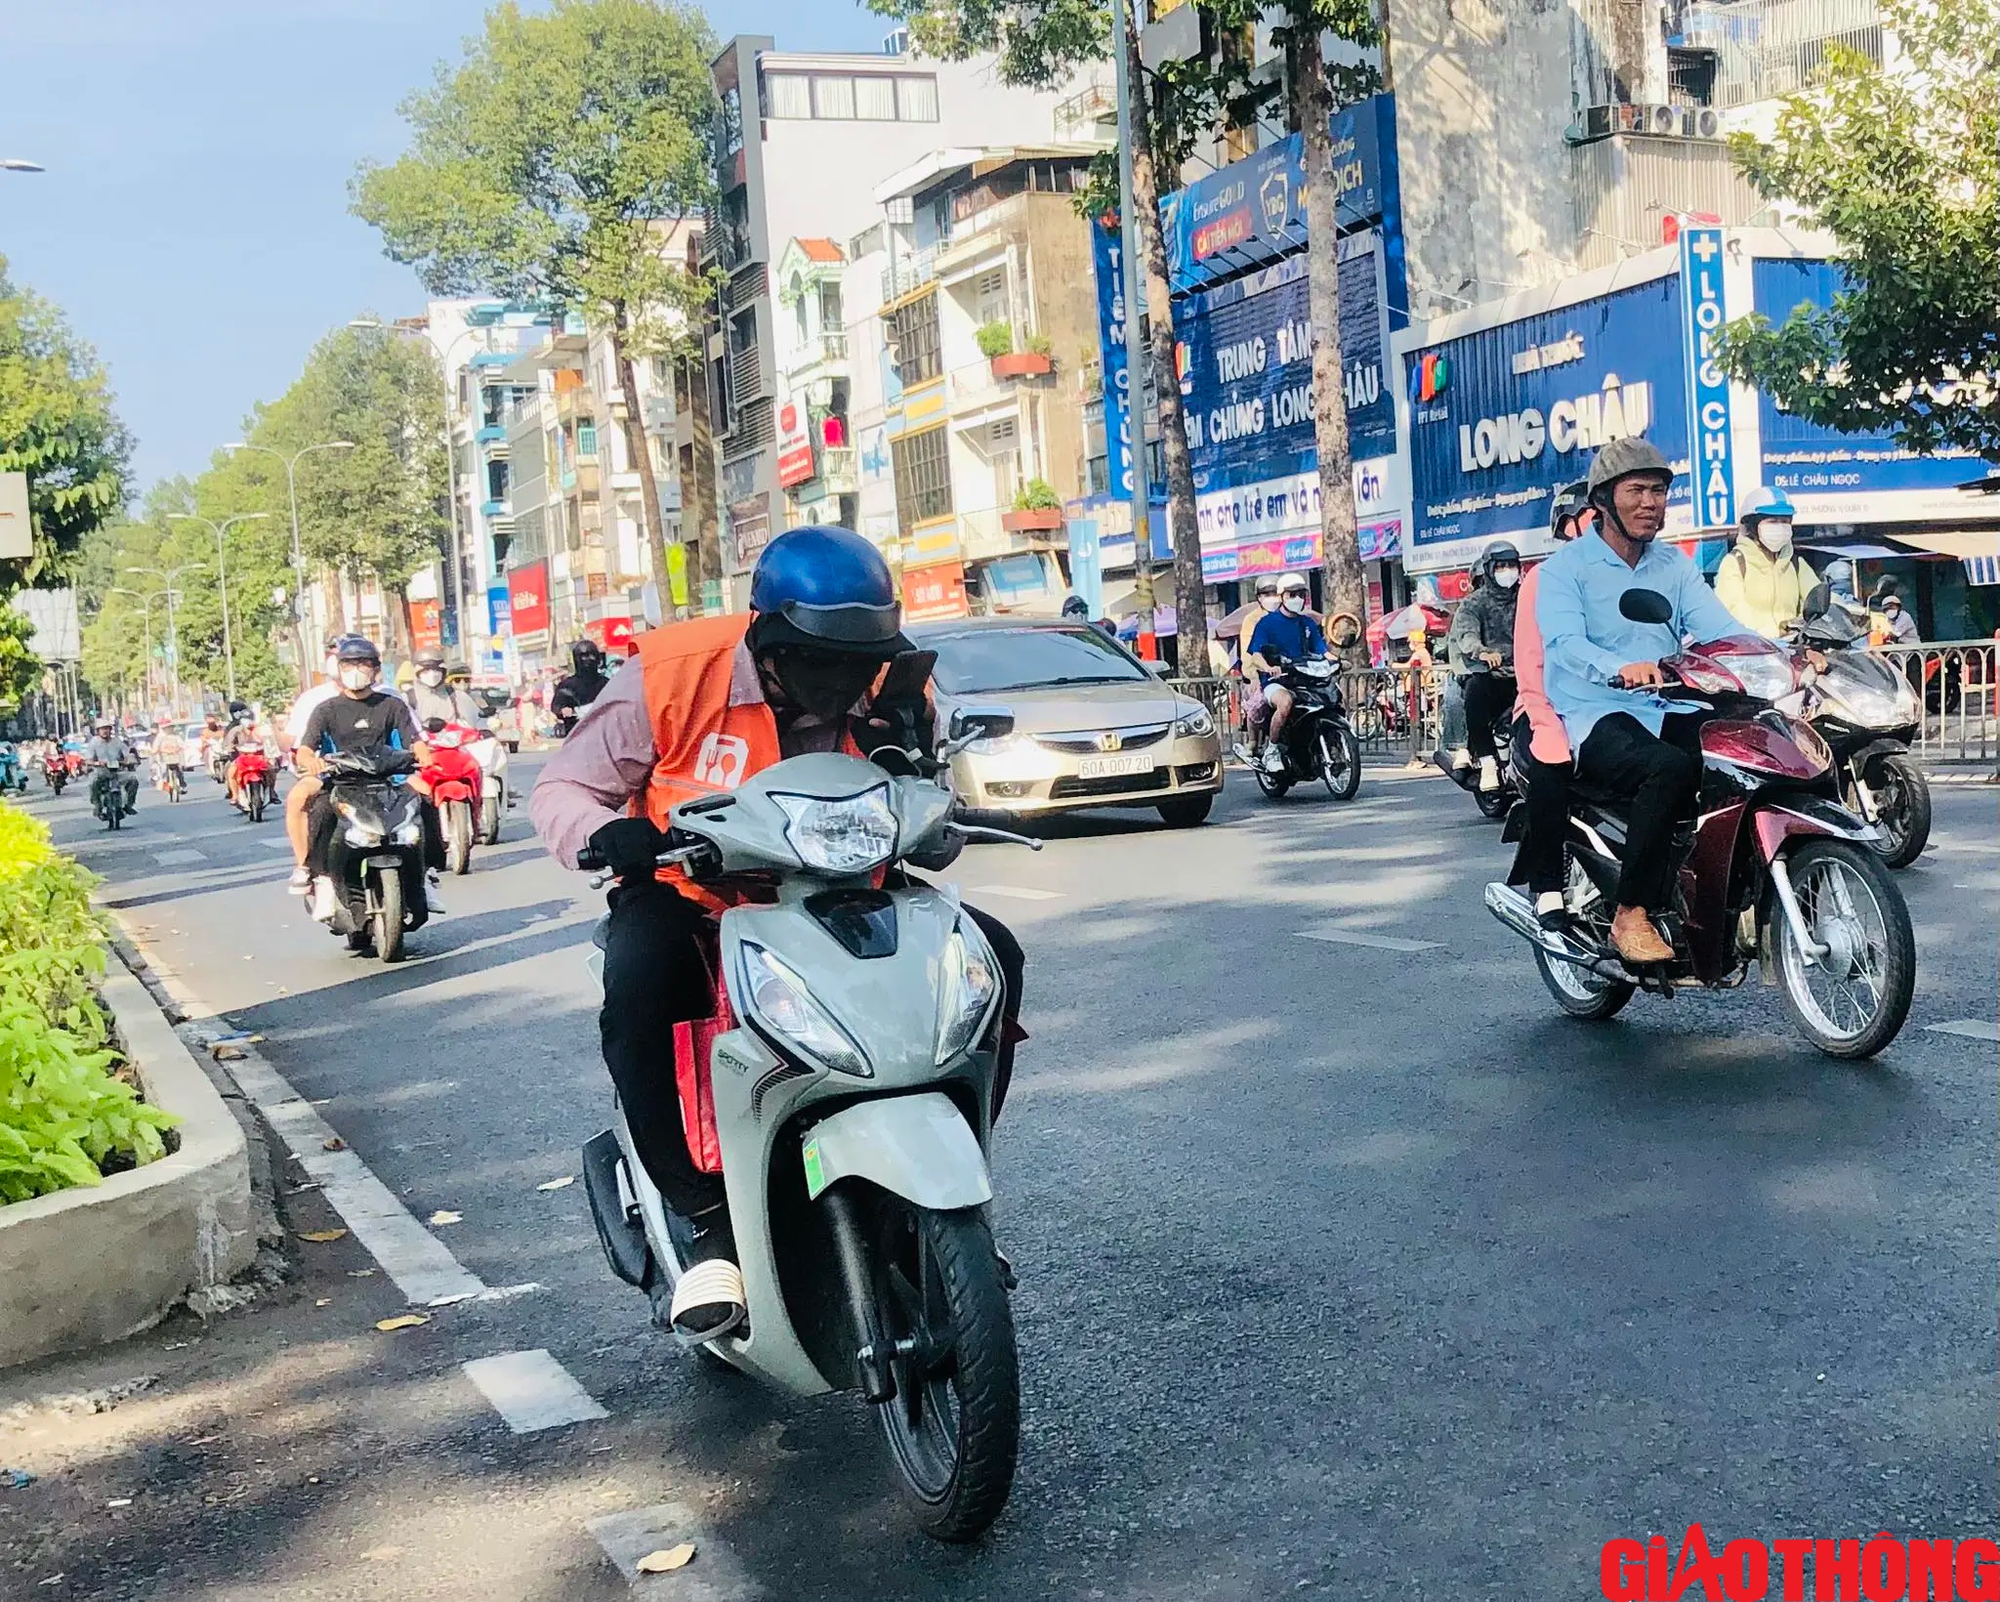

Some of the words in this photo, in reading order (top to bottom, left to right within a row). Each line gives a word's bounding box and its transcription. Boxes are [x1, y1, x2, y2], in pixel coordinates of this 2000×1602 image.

[1217, 336, 1266, 384] TRUNG
[1277, 318, 1312, 366] TÂM
[1696, 273, 1722, 388] LONG
[1184, 408, 1203, 449] ÊM
[1210, 391, 1265, 444] CHỦNG
[1272, 383, 1315, 429] LONG
[1345, 361, 1379, 409] HÂU
[1459, 408, 1545, 473] LONG
[1550, 373, 1651, 453] CHÂU
[1701, 401, 1729, 524] CHÂU
[1802, 473, 1828, 486] CHÂU
[1831, 474, 1860, 487] NGỌC
[1199, 501, 1214, 533] nh
[1217, 499, 1240, 527] cho
[1267, 492, 1288, 518] em
[1292, 482, 1307, 513] và
